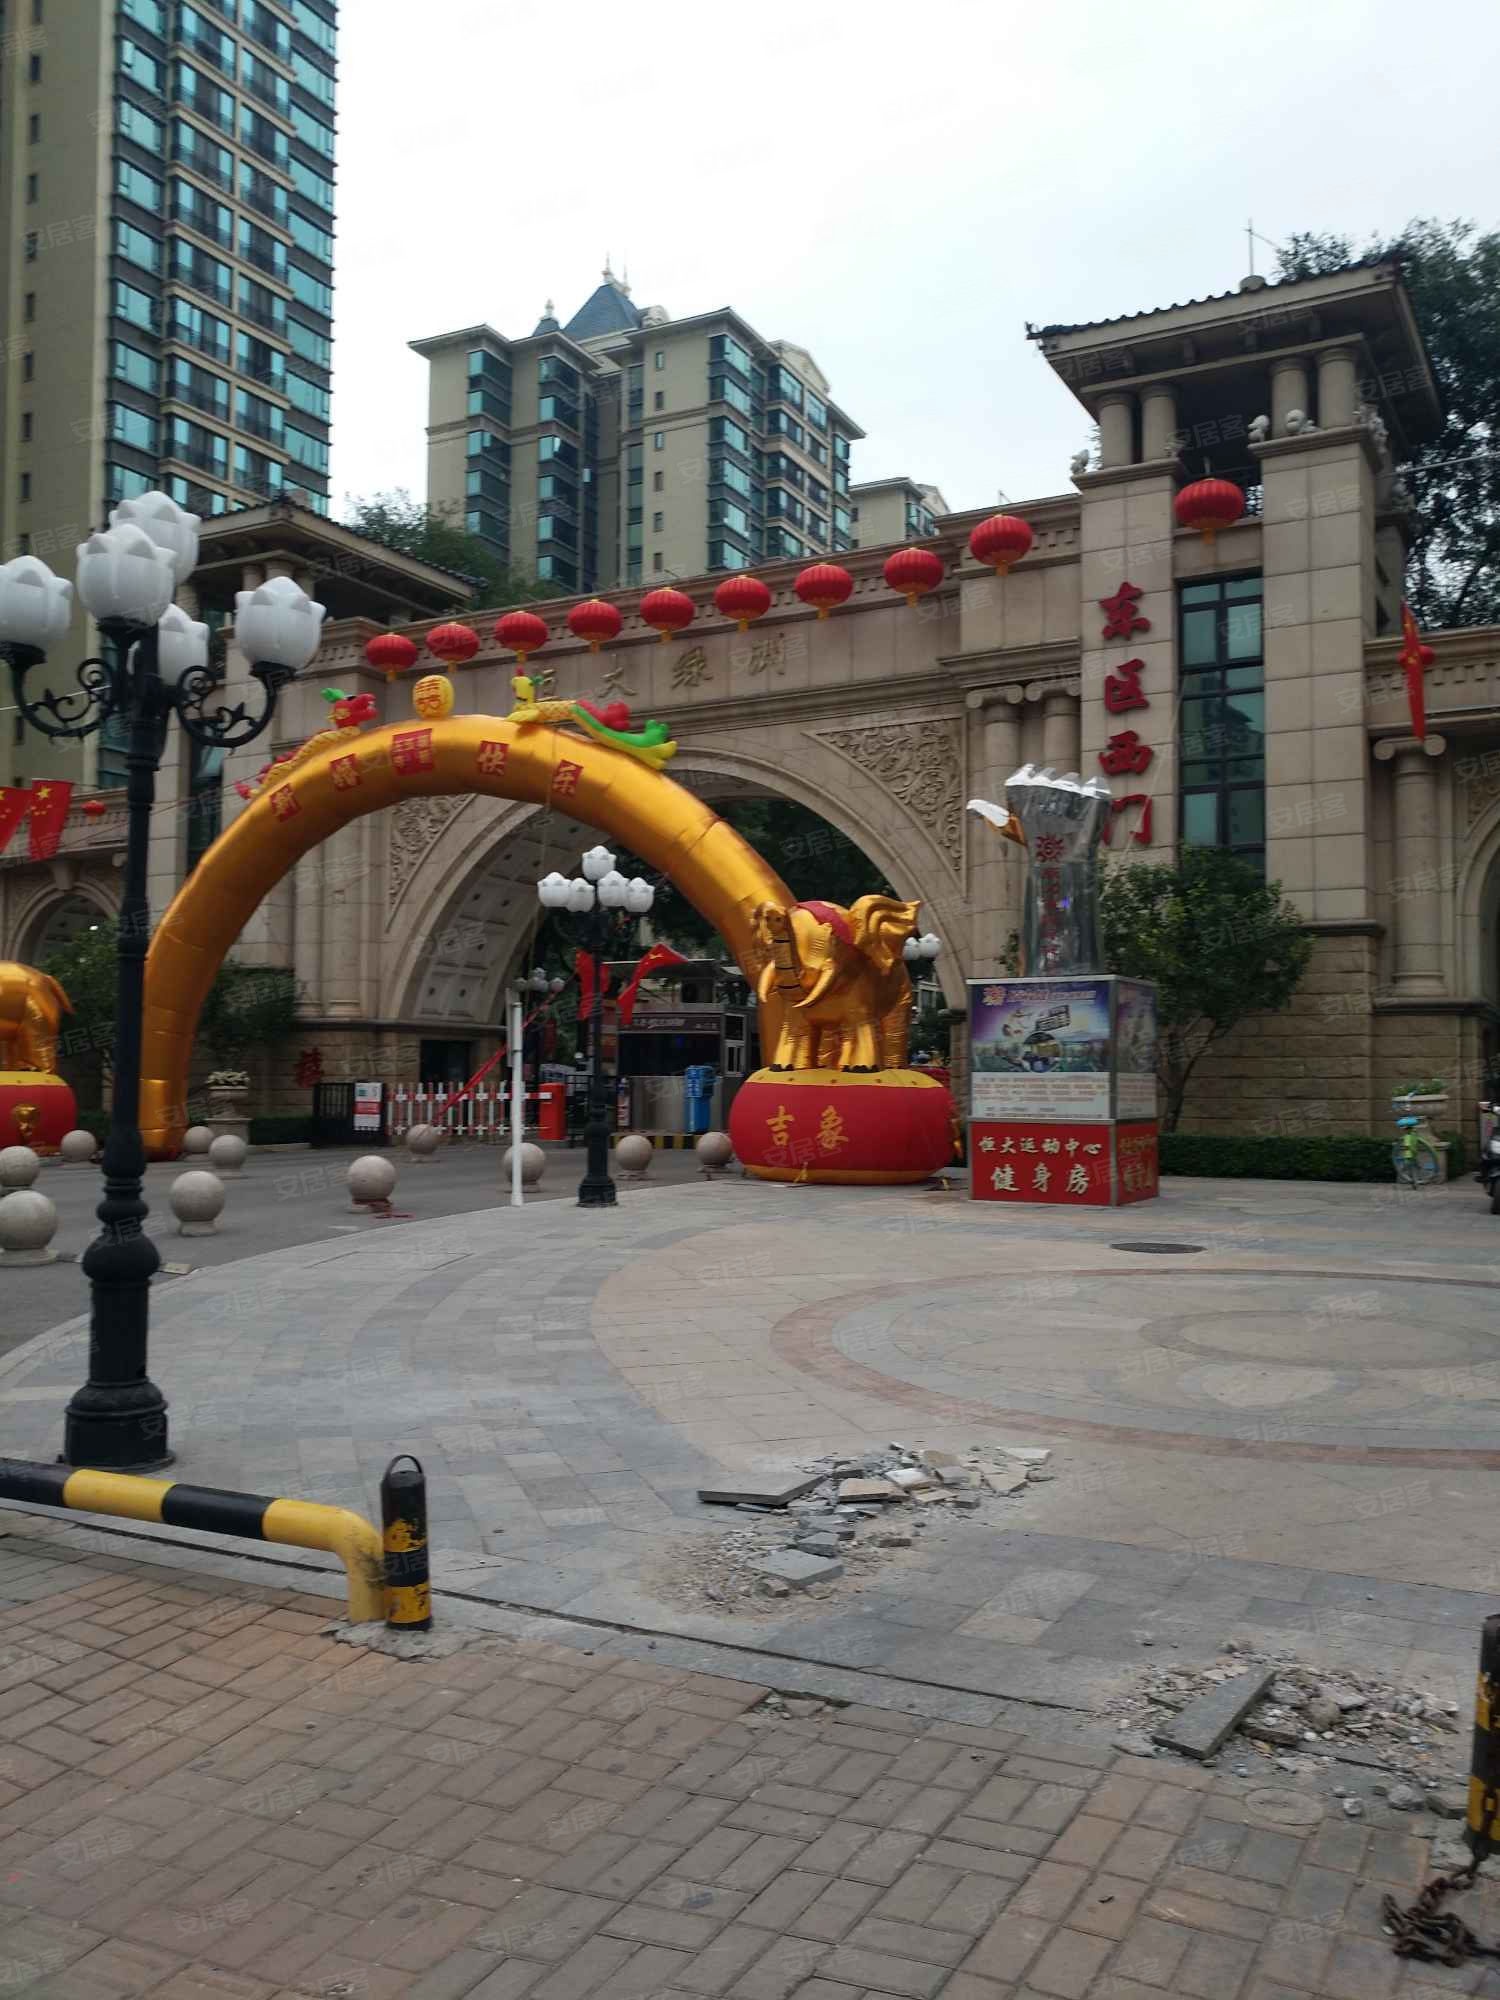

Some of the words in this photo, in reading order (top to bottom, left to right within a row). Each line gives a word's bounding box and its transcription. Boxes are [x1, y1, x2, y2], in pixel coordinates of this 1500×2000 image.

[1098, 581, 1153, 845] 东区西门
[766, 1105, 849, 1149] 吉象
[977, 1136, 1103, 1157] 恒大运动中心
[990, 1162, 1091, 1194] 健身房
